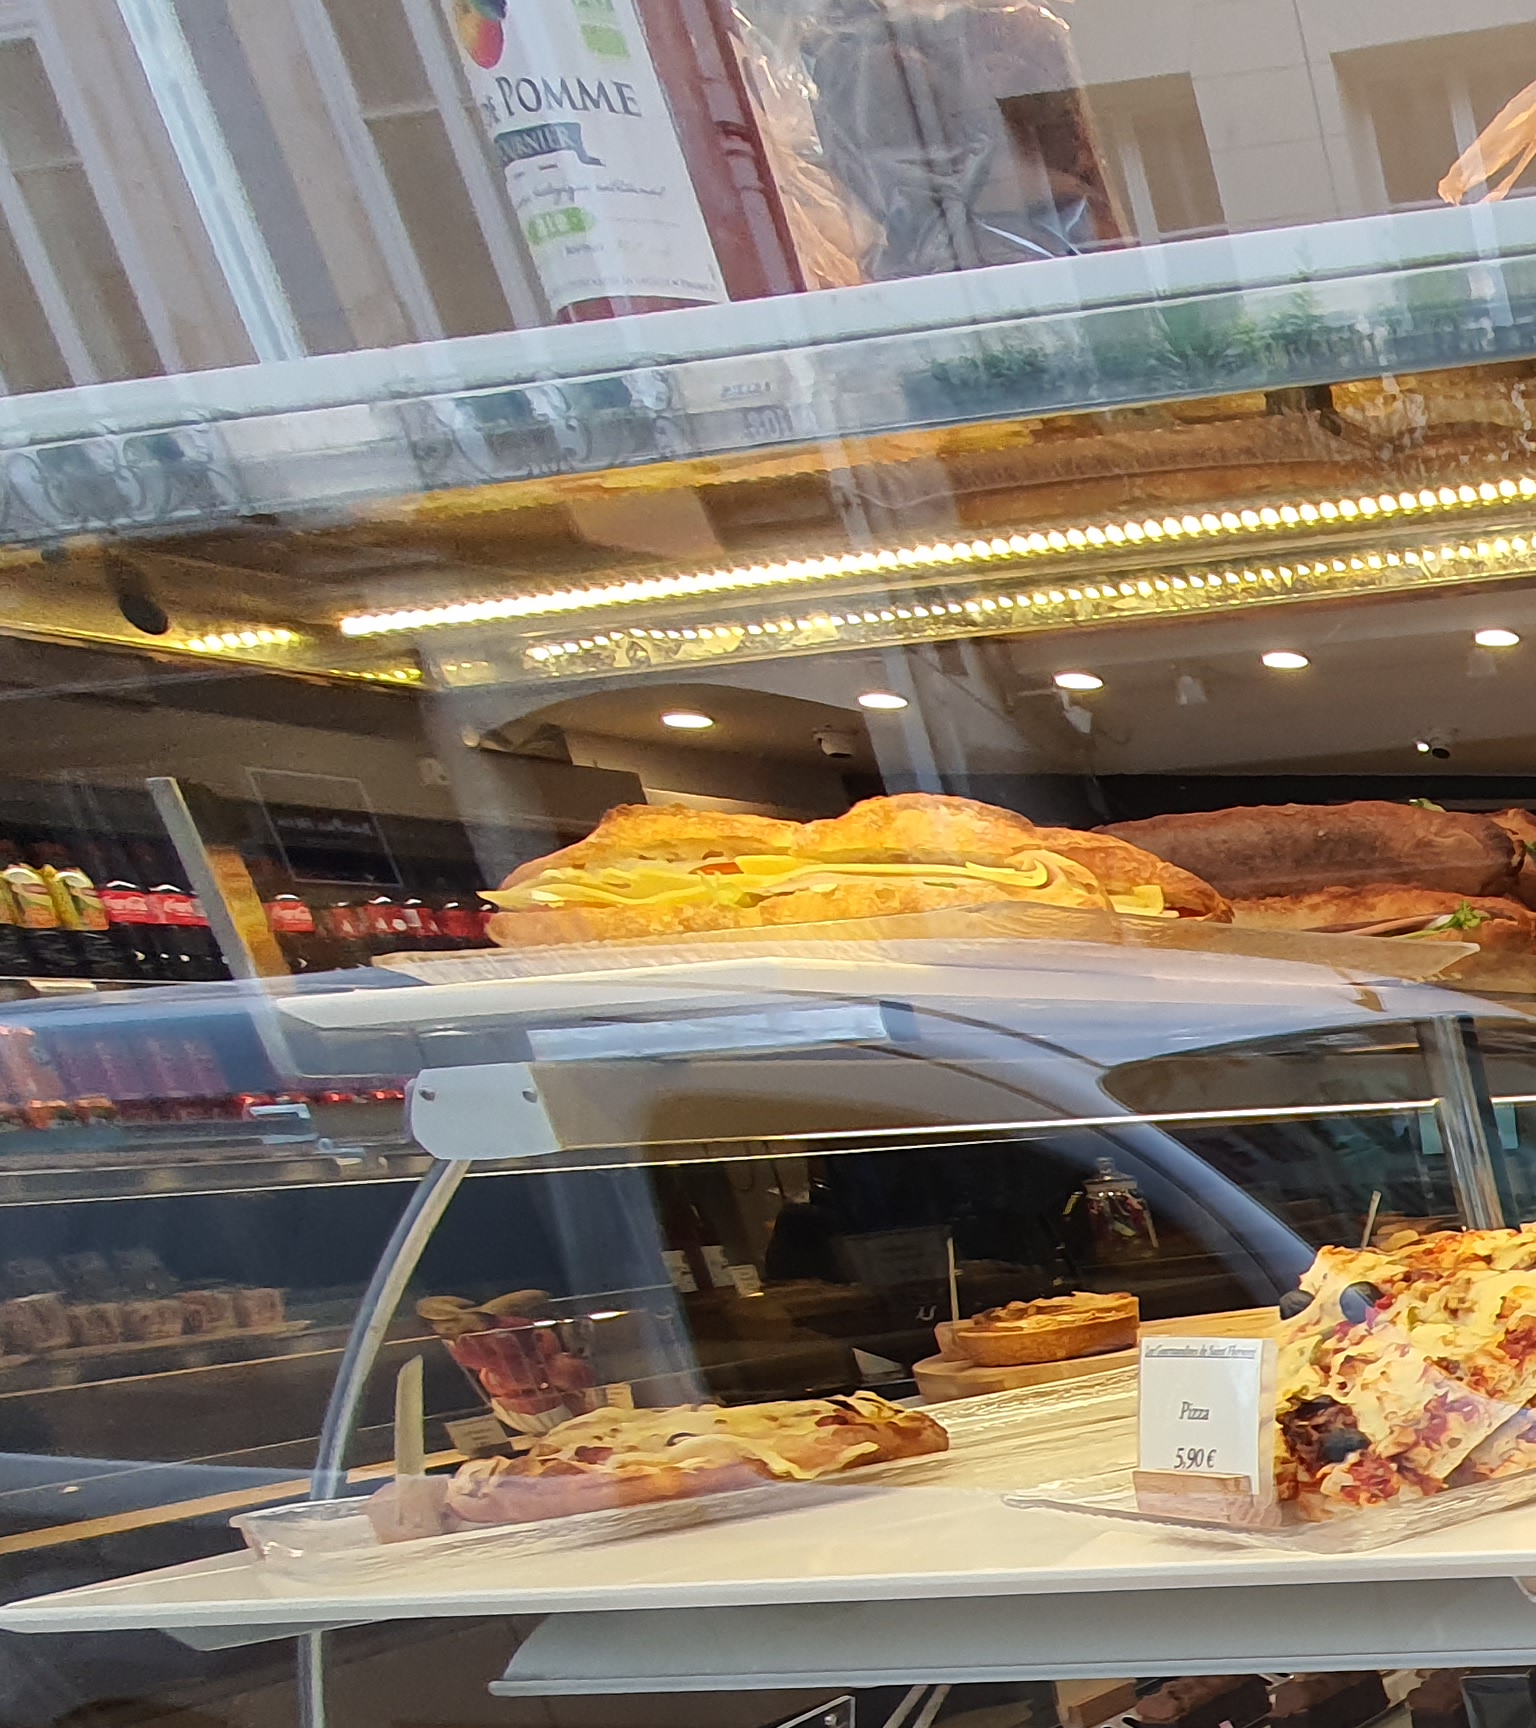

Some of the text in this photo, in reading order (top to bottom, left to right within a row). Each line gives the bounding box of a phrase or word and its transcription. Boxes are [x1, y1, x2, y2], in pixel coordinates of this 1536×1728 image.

[495, 76, 642, 118] POMME
[1178, 1401, 1210, 1420] Pizza
[1174, 1448, 1217, 1469] 5,90 €
